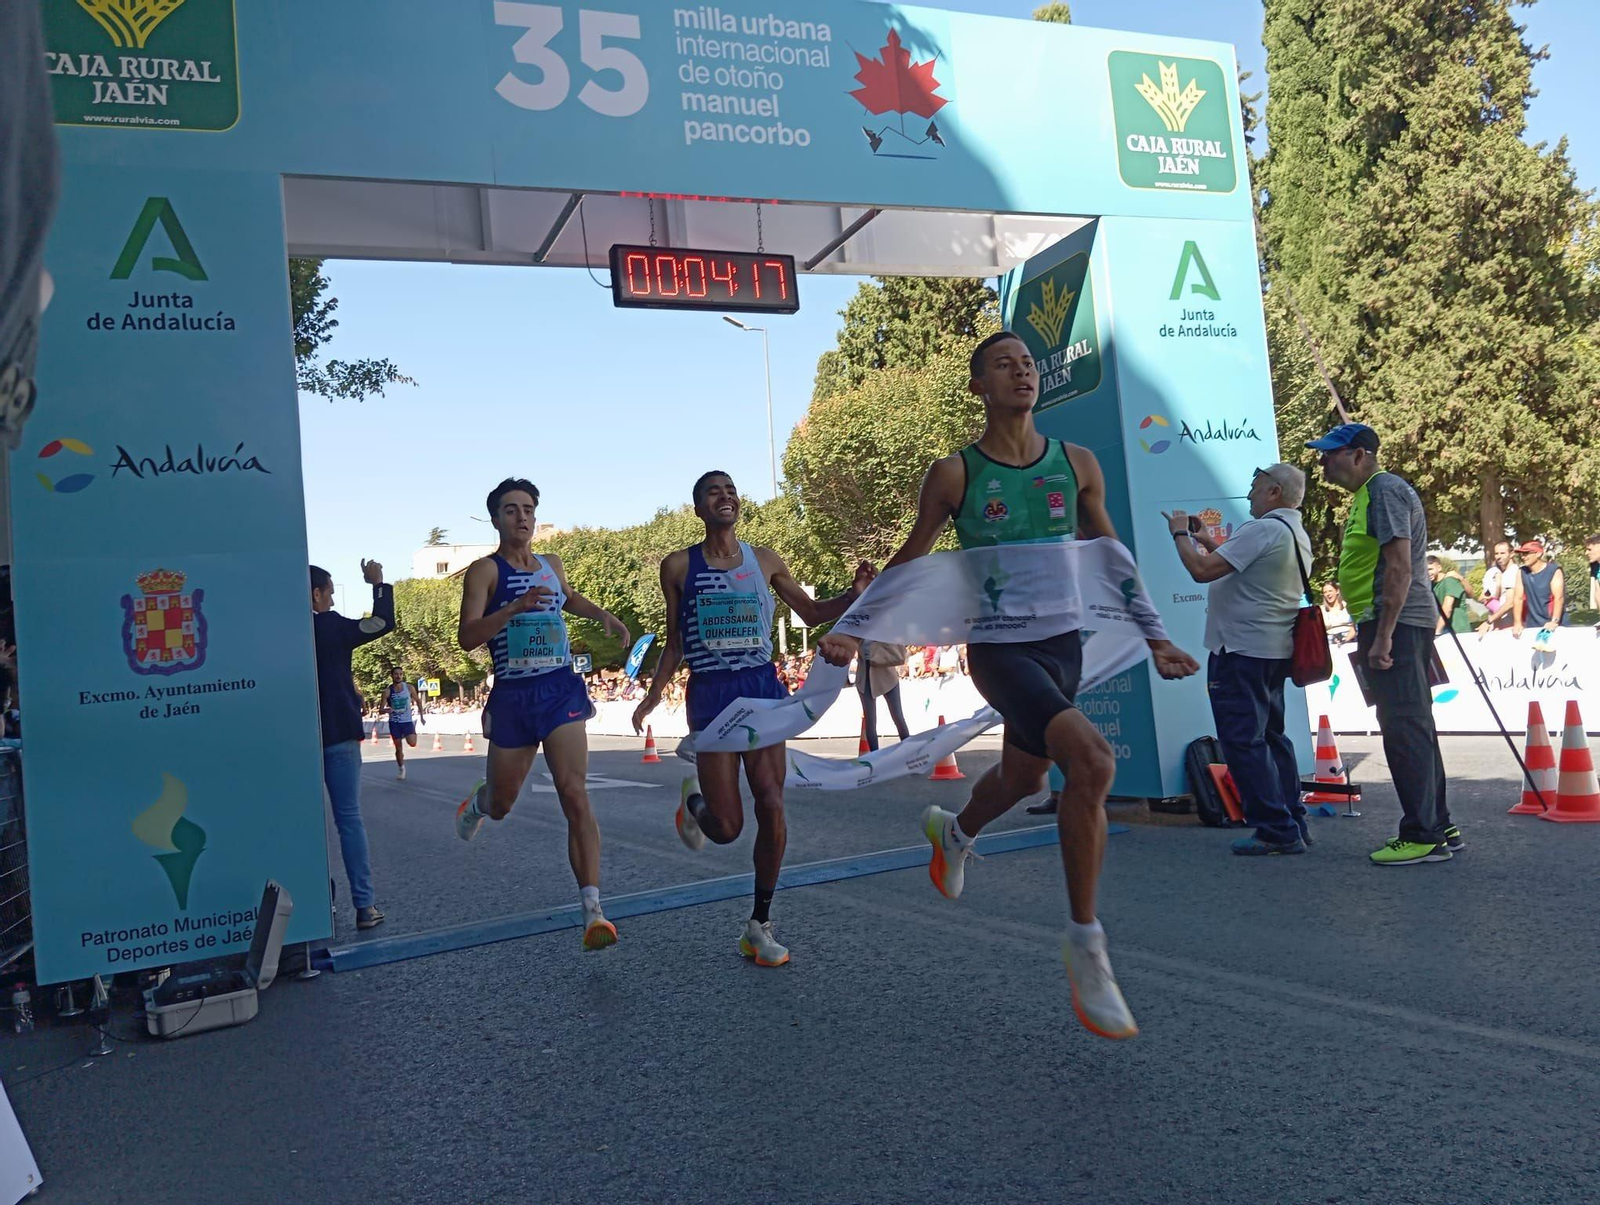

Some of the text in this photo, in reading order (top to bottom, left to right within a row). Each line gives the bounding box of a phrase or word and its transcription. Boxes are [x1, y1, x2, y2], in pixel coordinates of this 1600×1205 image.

[674, 6, 832, 42] milla urbana
[494, 1, 650, 117] 35
[675, 30, 830, 68] internacional
[44, 52, 221, 83] CAJA RURAL
[679, 59, 784, 90] de otoño
[92, 78, 169, 105] JAÉN
[681, 92, 779, 117] manuel
[83, 115, 180, 126] www.ruralvia.com
[684, 120, 811, 147] pancorbo
[1126, 134, 1227, 158] CAJA RURAL
[1158, 155, 1200, 175] JAÉN
[128, 291, 193, 308] Junta
[87, 311, 236, 331] de Andalucía
[1180, 308, 1215, 321] Junta
[1159, 323, 1237, 337] de Andalucía
[1050, 339, 1092, 370] RURAL
[1042, 366, 1072, 394] JAÉN
[1177, 418, 1262, 444] Andalucía
[108, 441, 273, 479] Andalucía
[699, 597, 712, 606] 35
[728, 606, 734, 614] 6
[1173, 593, 1205, 603] Excmo.
[702, 614, 758, 626] ABDESSAMAD
[705, 626, 758, 638] OUKHELFEN
[522, 647, 554, 657] ORIACH
[529, 636, 547, 646] POL
[79, 678, 256, 705] Excmo. Ayuntamiento
[139, 701, 201, 719] de Jaén
[1084, 696, 1120, 715] otoño
[81, 906, 258, 947] Patronato Municipal
[107, 925, 253, 962] Deportes de Jaé
